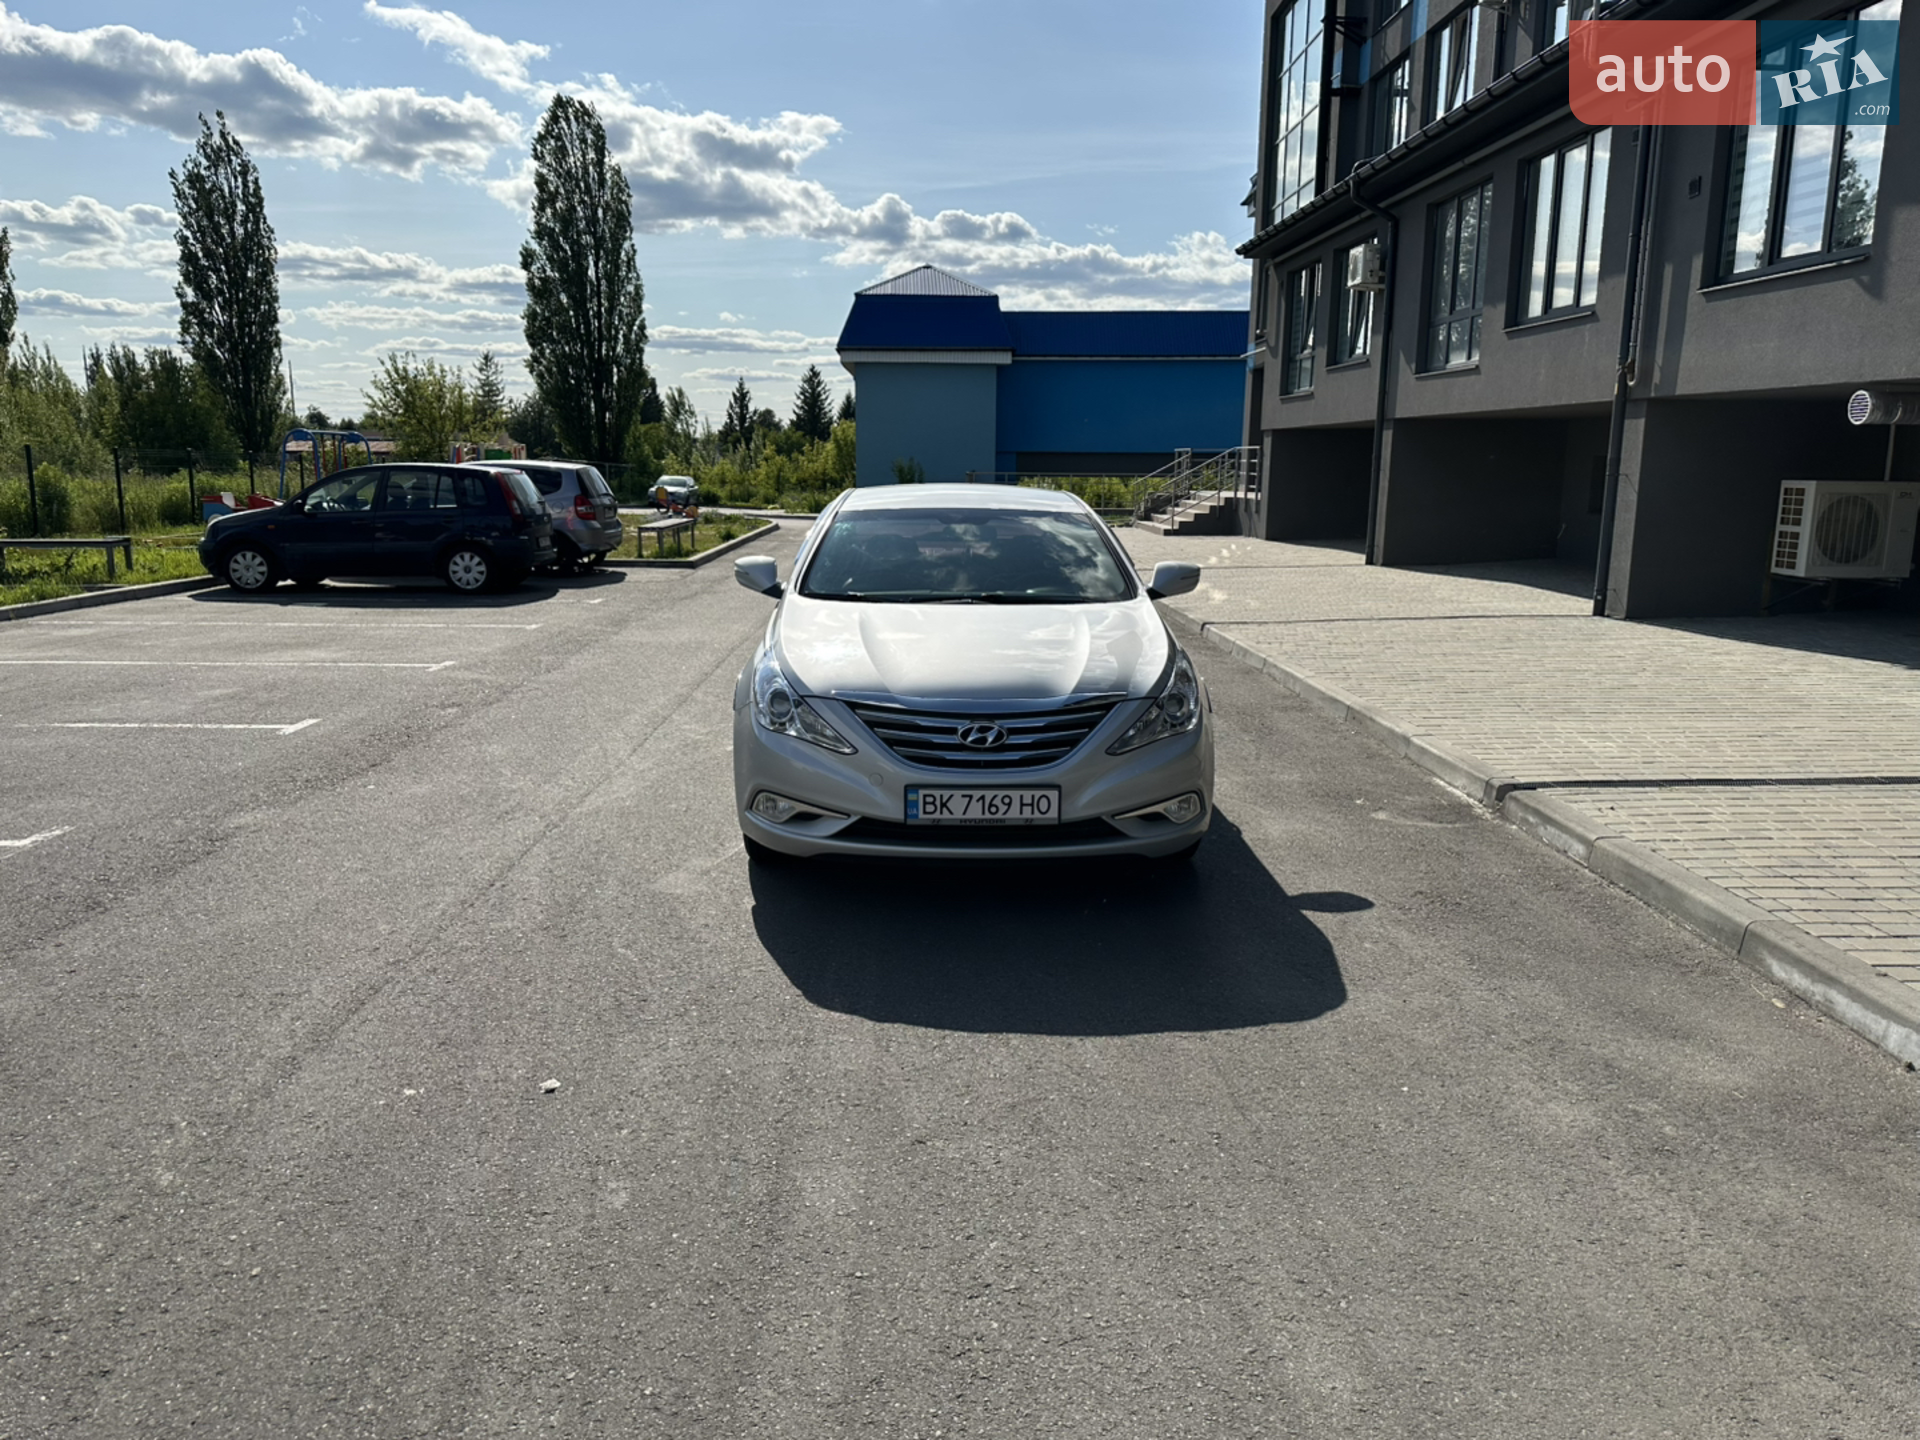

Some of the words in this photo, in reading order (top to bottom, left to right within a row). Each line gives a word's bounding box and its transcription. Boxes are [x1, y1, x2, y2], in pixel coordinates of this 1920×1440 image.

[907, 807, 918, 815] UA
[922, 794, 954, 815] BK
[960, 794, 1013, 815] 7169
[1019, 794, 1051, 815] HO
